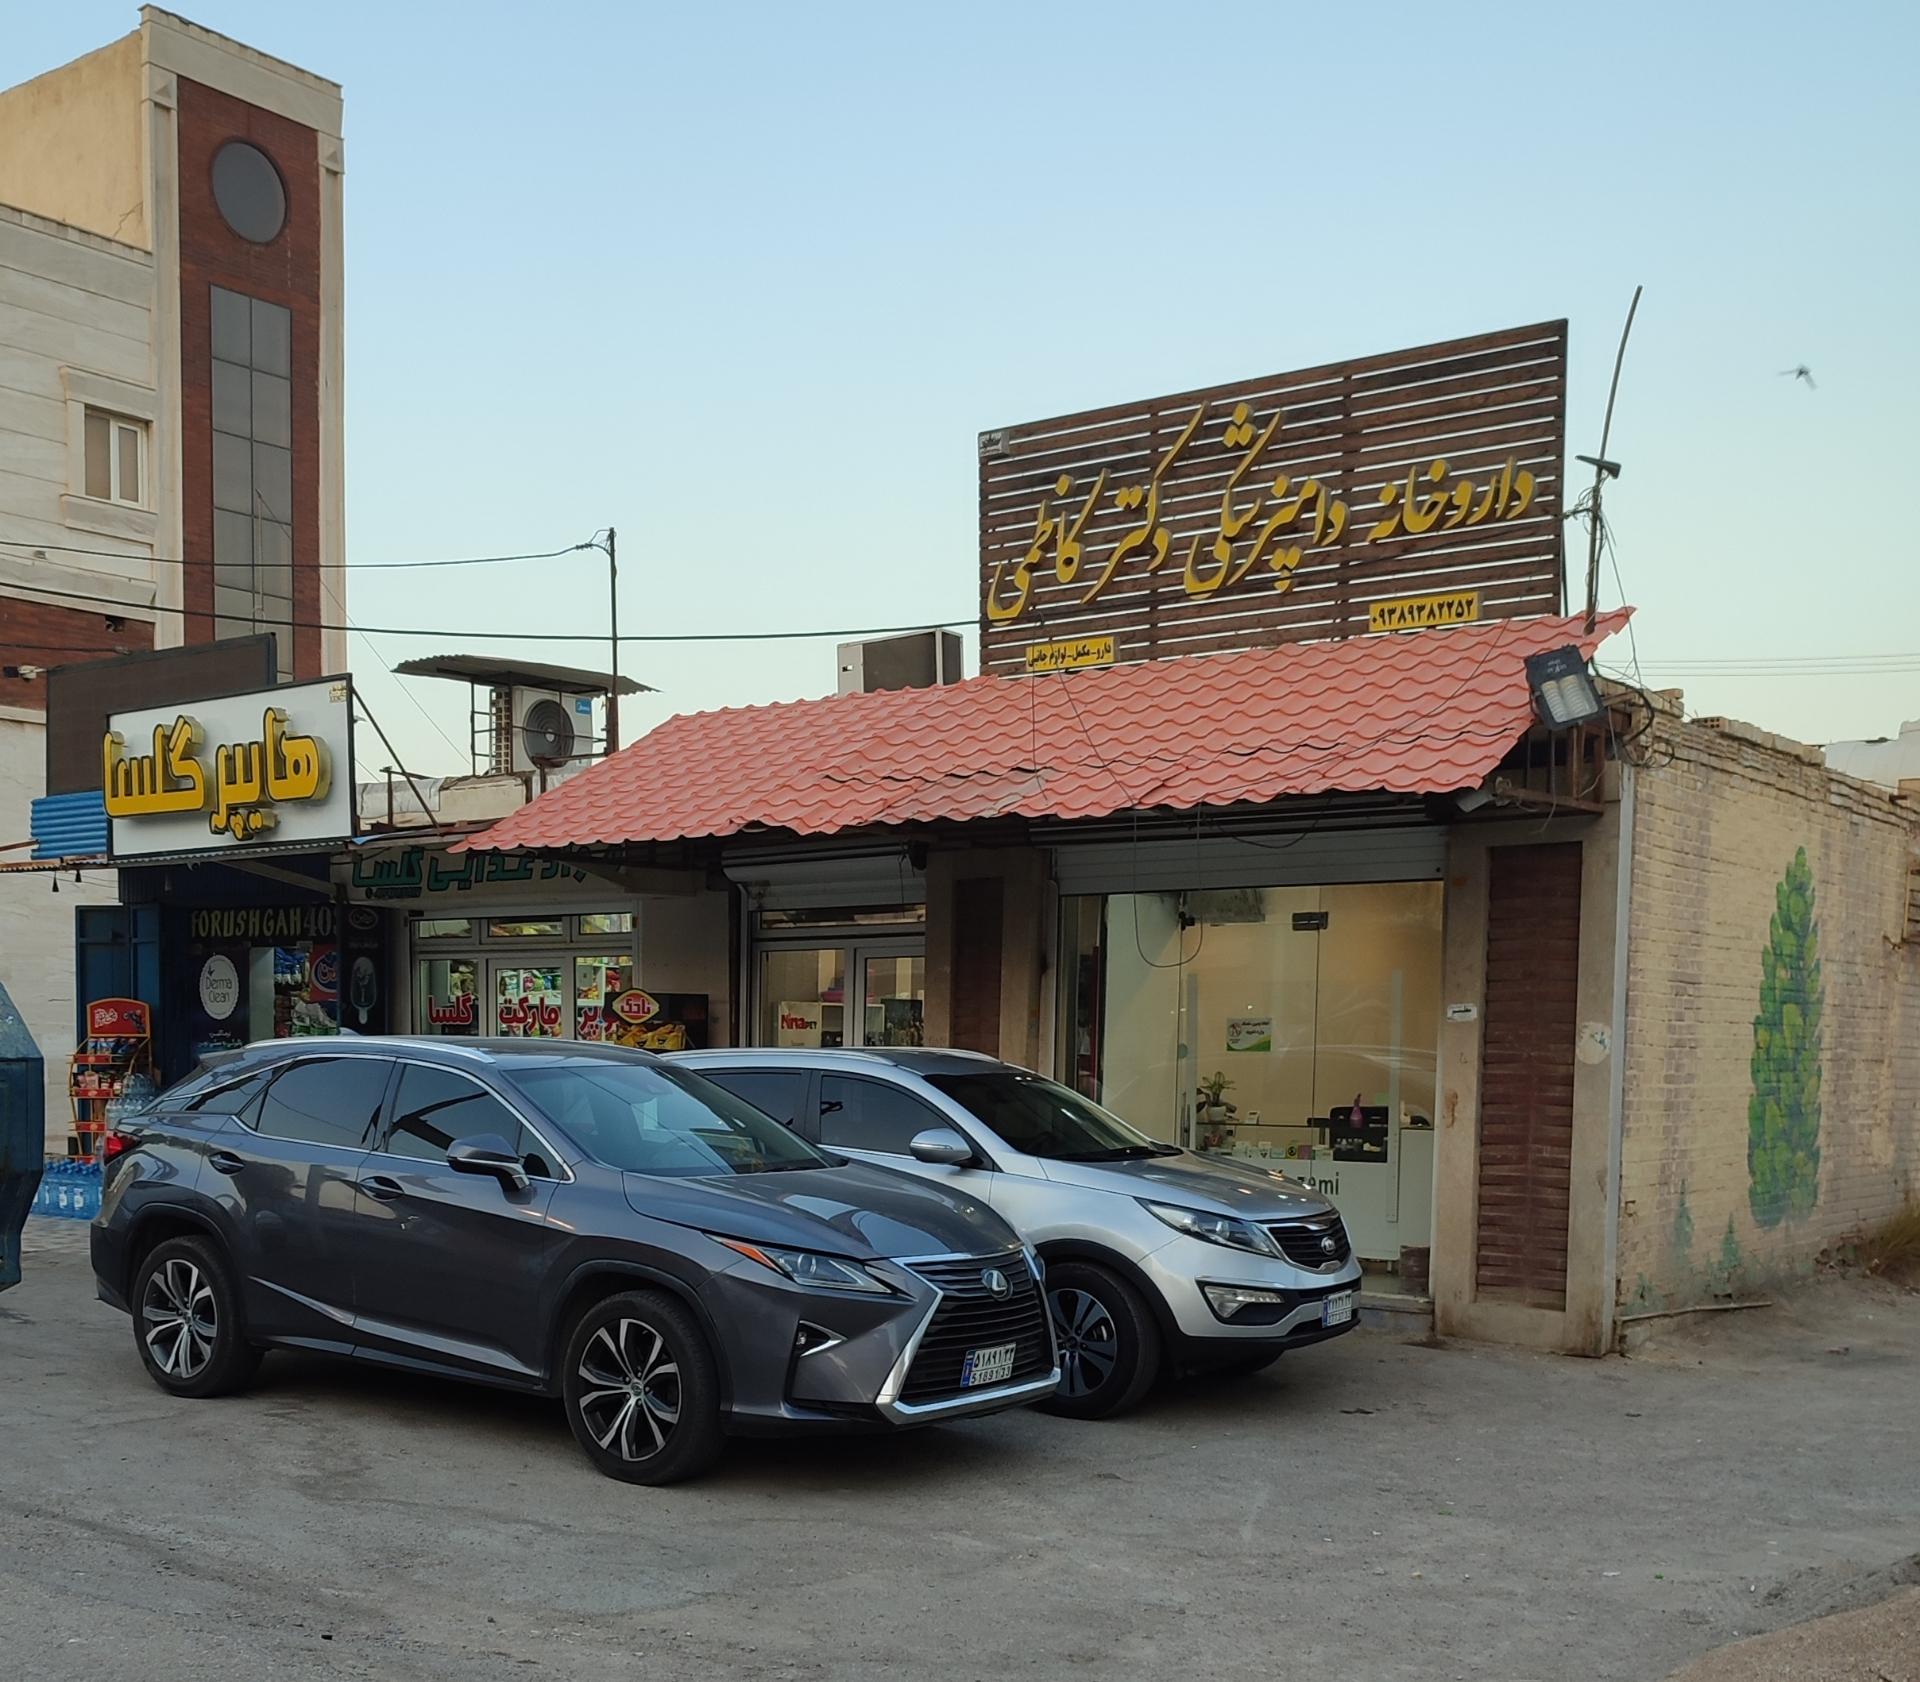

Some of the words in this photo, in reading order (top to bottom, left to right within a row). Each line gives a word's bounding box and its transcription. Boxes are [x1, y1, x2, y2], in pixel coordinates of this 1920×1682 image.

[1080, 400, 1209, 605] دکتر
[1184, 402, 1349, 600] دامپزشکی
[1365, 455, 1536, 543] داروخانه
[987, 467, 1110, 627] کاظمی
[104, 714, 205, 818] گلسا
[209, 707, 325, 841] هایپر
[303, 905, 337, 937] 40
[205, 976, 232, 990] Derma
[208, 991, 230, 1003] Clean
[428, 991, 472, 1025] گلسا
[499, 995, 560, 1033] مارکت
